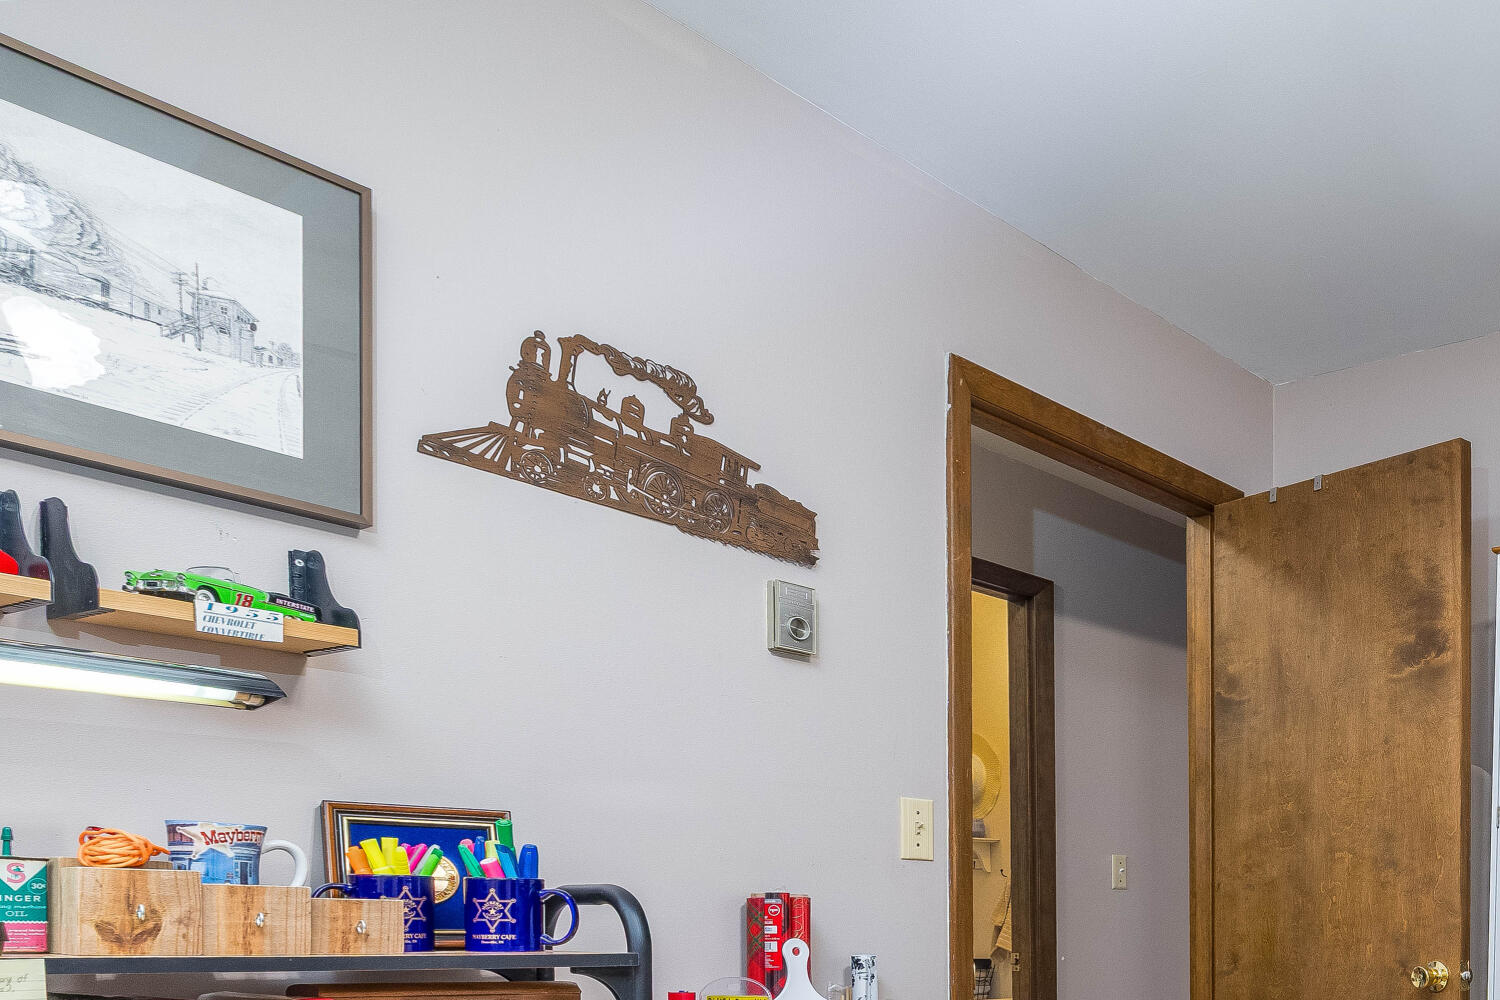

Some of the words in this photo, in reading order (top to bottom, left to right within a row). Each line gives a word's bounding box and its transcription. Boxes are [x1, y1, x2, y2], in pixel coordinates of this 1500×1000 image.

[235, 593, 254, 607] 18
[276, 598, 315, 612] INTERSTATE
[203, 615, 256, 629] CHEVROLET
